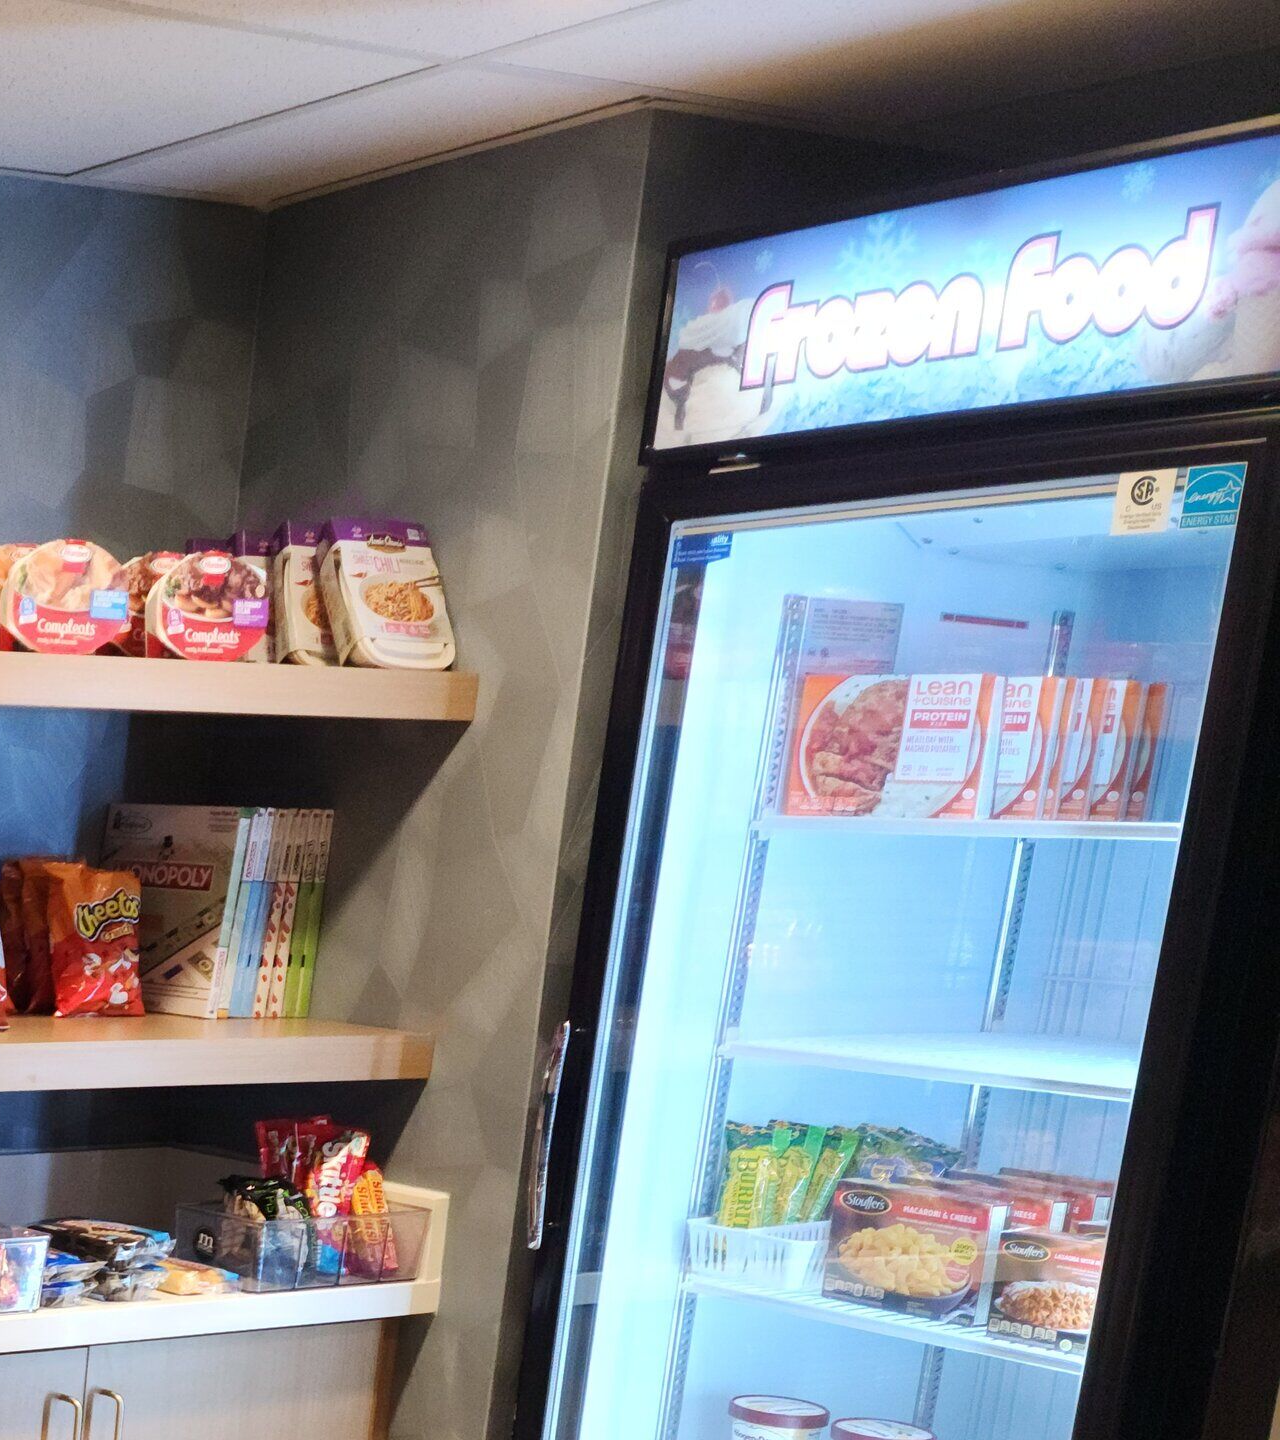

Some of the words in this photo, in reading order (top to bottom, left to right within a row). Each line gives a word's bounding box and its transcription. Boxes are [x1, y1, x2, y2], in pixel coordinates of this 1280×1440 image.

[740, 272, 985, 390] frozen
[996, 202, 1222, 352] food
[1181, 515, 1212, 527] ENERGY
[1214, 513, 1236, 525] STAR
[37, 618, 97, 639] Compleats
[185, 627, 240, 647] Compleats
[915, 680, 973, 696] Lean
[913, 711, 968, 722] PROTEIN
[130, 863, 213, 889] ONOPOLY
[736, 1157, 758, 1229] BURRIT
[845, 1193, 886, 1211] Stouffer's
[903, 1205, 941, 1218] MACARONI
[949, 1213, 978, 1225] CHEESE
[1013, 1209, 1038, 1220] HEESE
[1008, 1242, 1046, 1259] Stouffer's
